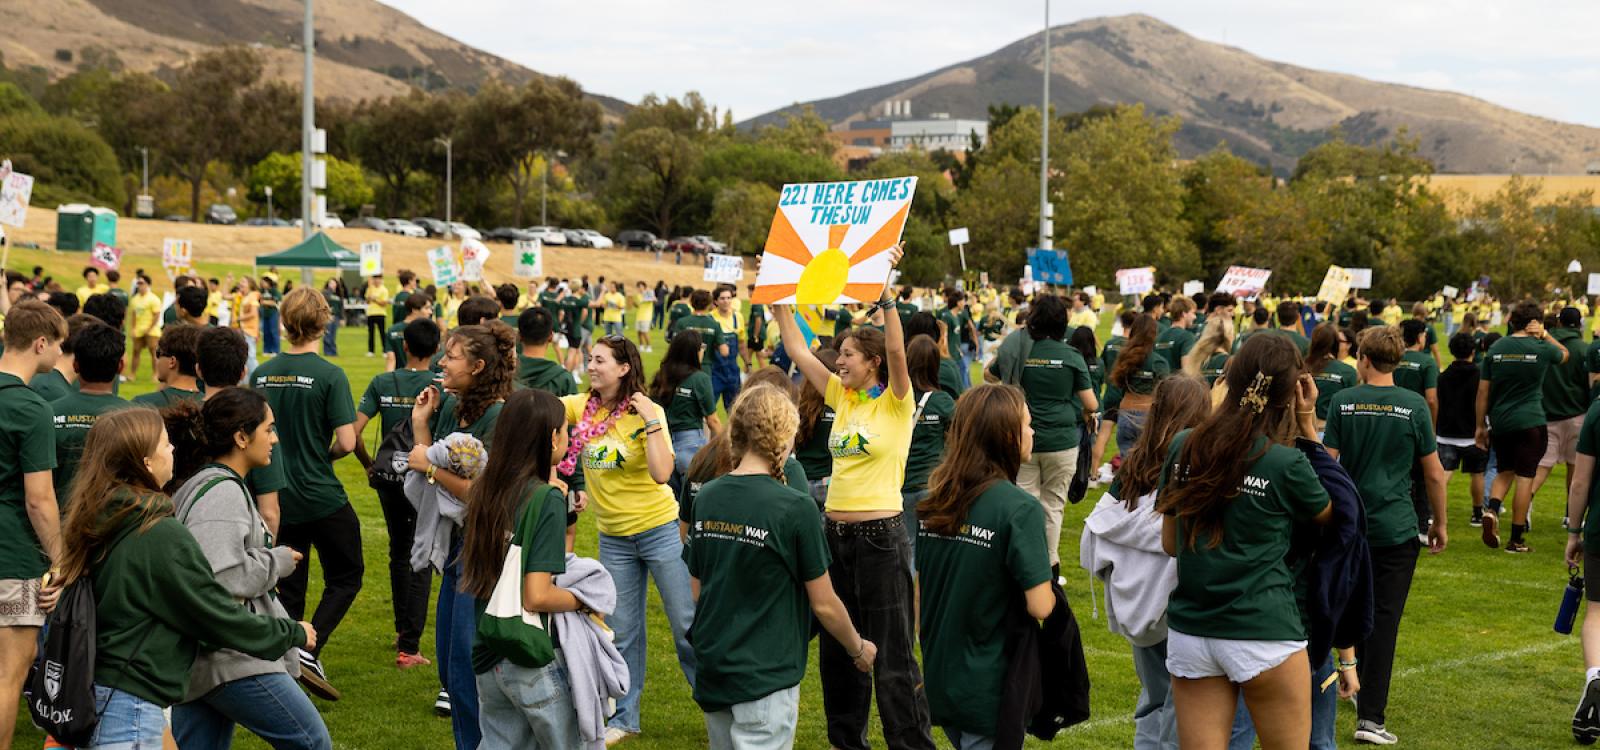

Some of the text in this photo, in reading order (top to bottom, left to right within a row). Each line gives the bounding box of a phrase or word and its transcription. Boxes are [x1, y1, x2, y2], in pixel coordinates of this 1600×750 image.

[780, 178, 912, 206] 221 HERE COMES
[53, 415, 66, 424] HE
[1243, 475, 1270, 490] WAY
[703, 520, 745, 535] MUSTANG
[745, 525, 769, 541] WAY
[971, 524, 996, 541] WAY
